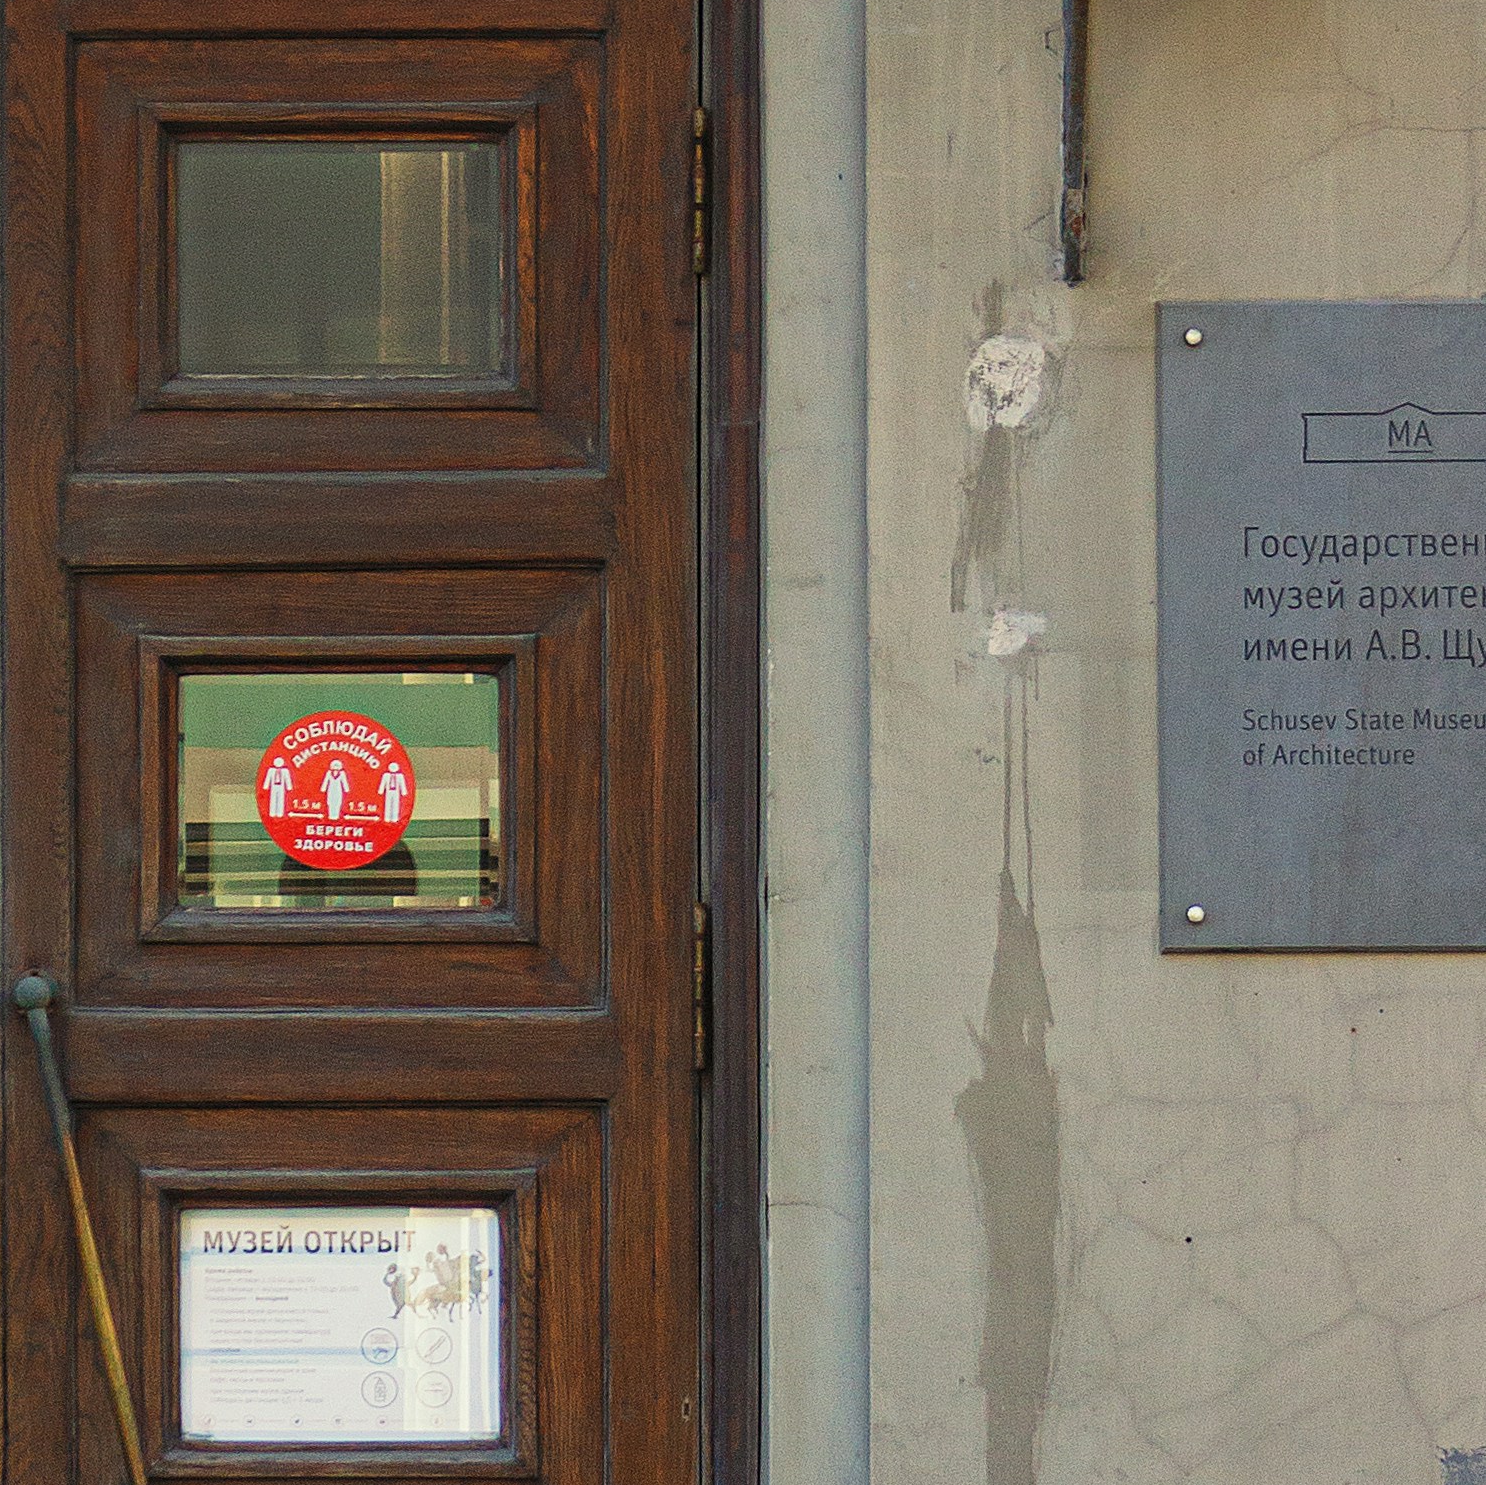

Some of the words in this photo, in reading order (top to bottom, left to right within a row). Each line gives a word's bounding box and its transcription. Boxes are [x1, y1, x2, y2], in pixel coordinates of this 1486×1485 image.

[1243, 526, 1486, 565] Государствен
[1243, 579, 1345, 618] музей
[1358, 585, 1486, 618] архите
[1243, 637, 1352, 662] имени
[1366, 629, 1432, 661] А.В.
[1242, 708, 1337, 731] Schusev
[1345, 708, 1405, 731] State
[283, 720, 394, 755] СОБЛЮДАЙ
[291, 740, 381, 769] ДИСТАНЦИЮ
[1242, 743, 1266, 766] of
[1272, 744, 1415, 766] Architecture
[293, 838, 374, 853] ЗДОРОВЬЕ
[305, 824, 364, 837] БЕРЕГИ
[203, 1223, 295, 1254] МУЗЕЙ
[303, 1229, 417, 1254] ОТКРЫТ
